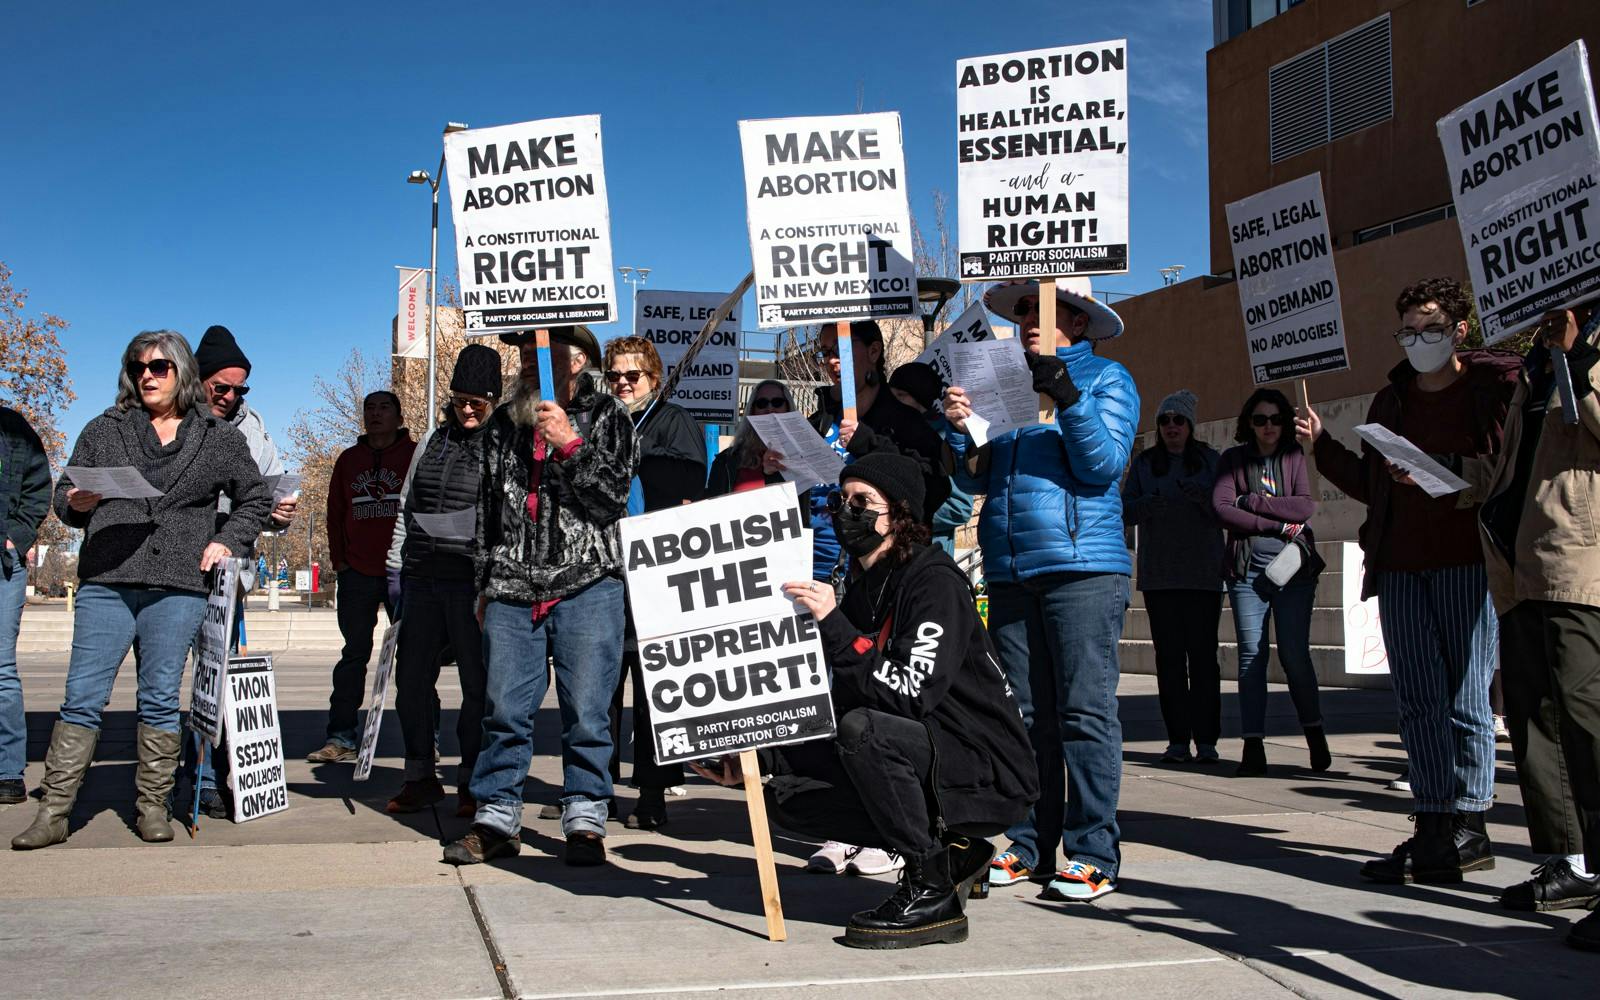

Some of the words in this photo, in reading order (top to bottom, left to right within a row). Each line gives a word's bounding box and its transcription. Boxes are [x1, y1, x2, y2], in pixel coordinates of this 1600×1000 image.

[959, 47, 1125, 88] ABORTION
[1030, 85, 1050, 105] IS
[959, 99, 1125, 132] HEALTHCARE,
[1459, 70, 1563, 156] MAKE
[467, 133, 578, 178] MAKE
[765, 128, 881, 166] MAKE
[959, 126, 1127, 163] ESSENTIAL,
[1460, 110, 1584, 195] ABORTION
[463, 173, 595, 212] ABORTION
[757, 168, 897, 198] ABORTION
[983, 191, 1096, 218] HUMAN
[1471, 234, 1479, 248] A
[1481, 174, 1597, 241] CONSTITUTIONAL
[760, 228, 771, 241] A
[775, 222, 900, 239] CONSTITUTIONAL
[987, 218, 1098, 248] RIGHT!
[1232, 216, 1270, 244] SAFE,
[1272, 199, 1321, 231] LEGAL
[465, 235, 474, 248] A
[477, 228, 600, 247] CONSTITUTIONAL
[1480, 197, 1590, 285] RIGHT
[473, 246, 591, 285] RIGHT
[770, 240, 893, 278] RIGHT
[963, 262, 985, 275] PSL
[989, 252, 1023, 263] PARTY
[1025, 250, 1046, 262] FOR
[1048, 247, 1108, 260] SOCIALISM
[989, 265, 1011, 276] AND
[1013, 262, 1075, 275] LIBERATION
[1239, 233, 1328, 280] ABORTION
[464, 291, 480, 306] IN
[486, 288, 527, 305] NEW
[532, 284, 606, 302] MEXICO!
[760, 284, 778, 300] IN
[784, 281, 828, 298] NEW
[834, 277, 910, 297] MEXICO!
[1246, 304, 1267, 326] ON
[1269, 279, 1334, 318] DEMAND
[1479, 292, 1495, 312] IN
[1497, 271, 1534, 303] NEW
[408, 287, 417, 341] WELCOME
[485, 315, 508, 323] PARTY
[522, 313, 558, 321] SOCIALISM
[565, 309, 605, 318] LIBERATION
[643, 305, 685, 322] SAFE,
[784, 309, 807, 317] PARTY
[824, 305, 861, 315] SOCIALISM
[869, 303, 909, 311] LIBERATION
[1502, 309, 1521, 324] PARTY
[1522, 304, 1535, 315] FOR
[1535, 289, 1571, 308] SOCIALISM
[1251, 337, 1268, 353] NO
[1271, 319, 1338, 350] APOLOGIES!
[670, 390, 732, 400] POLOGIES!
[628, 507, 802, 571] ABOLISH
[667, 556, 772, 613] THE
[642, 612, 818, 672] SUPREME
[910, 621, 944, 675] ONE
[231, 675, 270, 702] NOW!
[652, 651, 821, 713] COURT!
[236, 706, 258, 732] NM
[261, 704, 274, 727] IN
[697, 721, 729, 736] PARTY
[731, 717, 755, 730] FOR
[756, 705, 817, 725] SOCIALISM
[236, 737, 278, 768] ACCESS
[661, 734, 695, 757] PSL
[699, 740, 708, 750] &
[709, 729, 773, 750] LIBERATION
[239, 764, 282, 792] ABORTION
[242, 786, 286, 818] EXPAND
